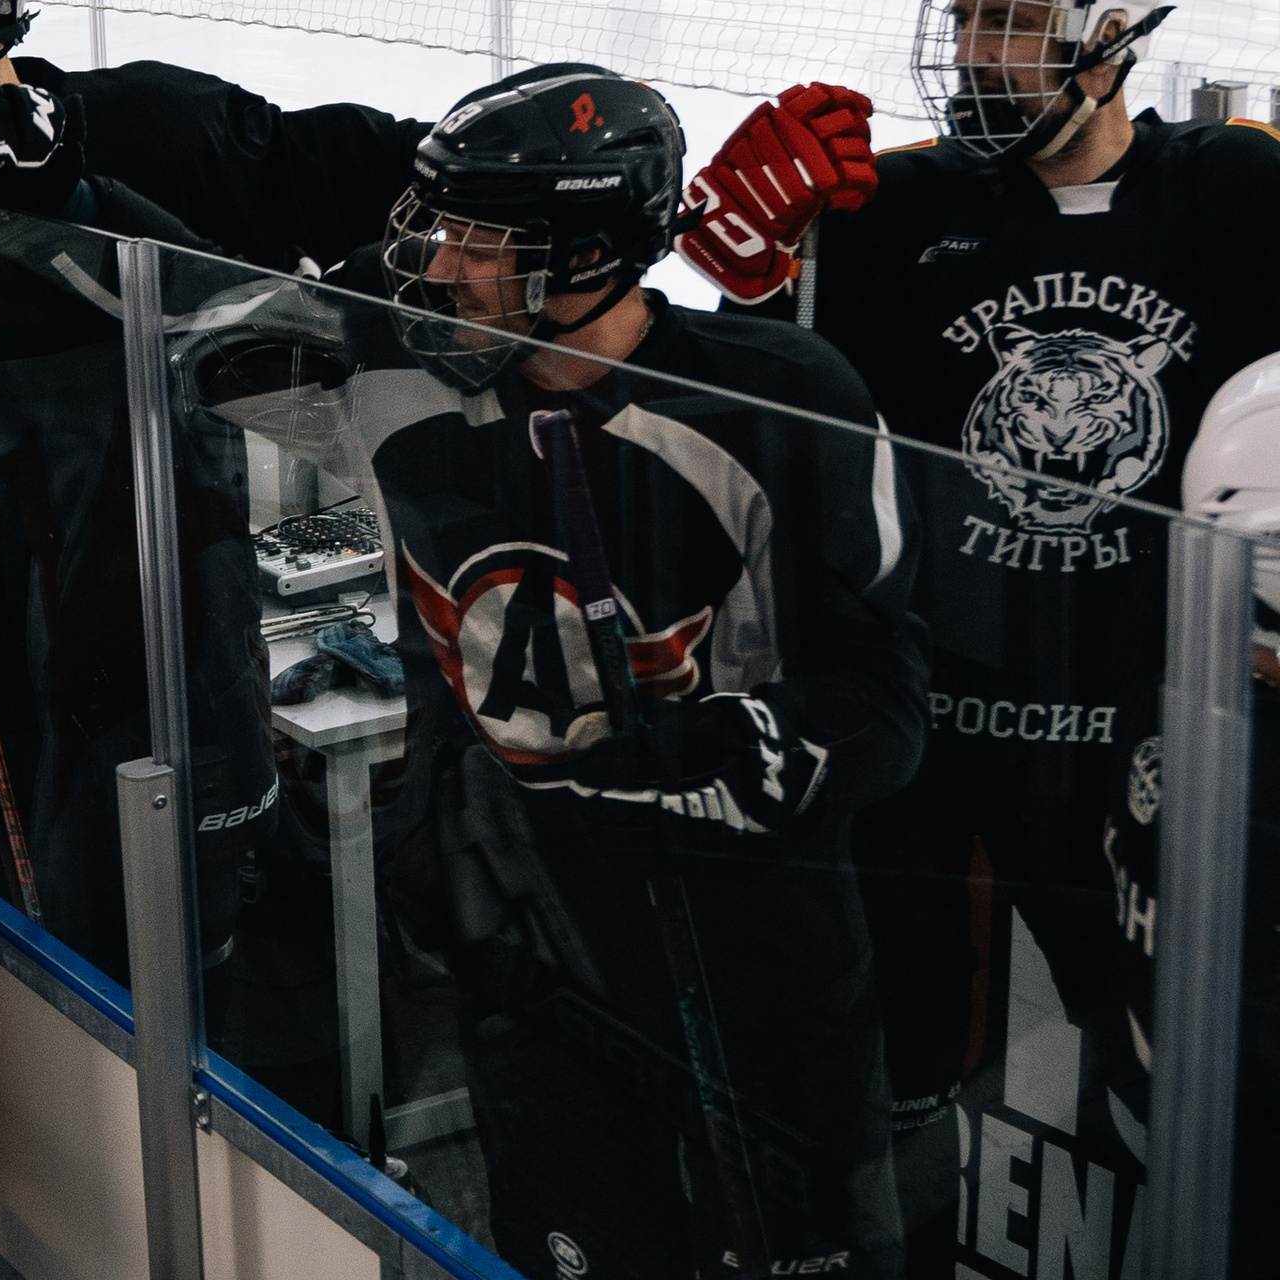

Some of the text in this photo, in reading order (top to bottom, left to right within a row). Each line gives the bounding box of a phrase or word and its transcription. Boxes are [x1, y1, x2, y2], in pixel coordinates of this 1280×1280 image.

[555, 174, 622, 191] BAUER
[941, 270, 1199, 363] УРАЛЬСКИЕ
[959, 513, 1132, 573] ТИГРЫ
[927, 691, 1118, 744] РОССИЯ
